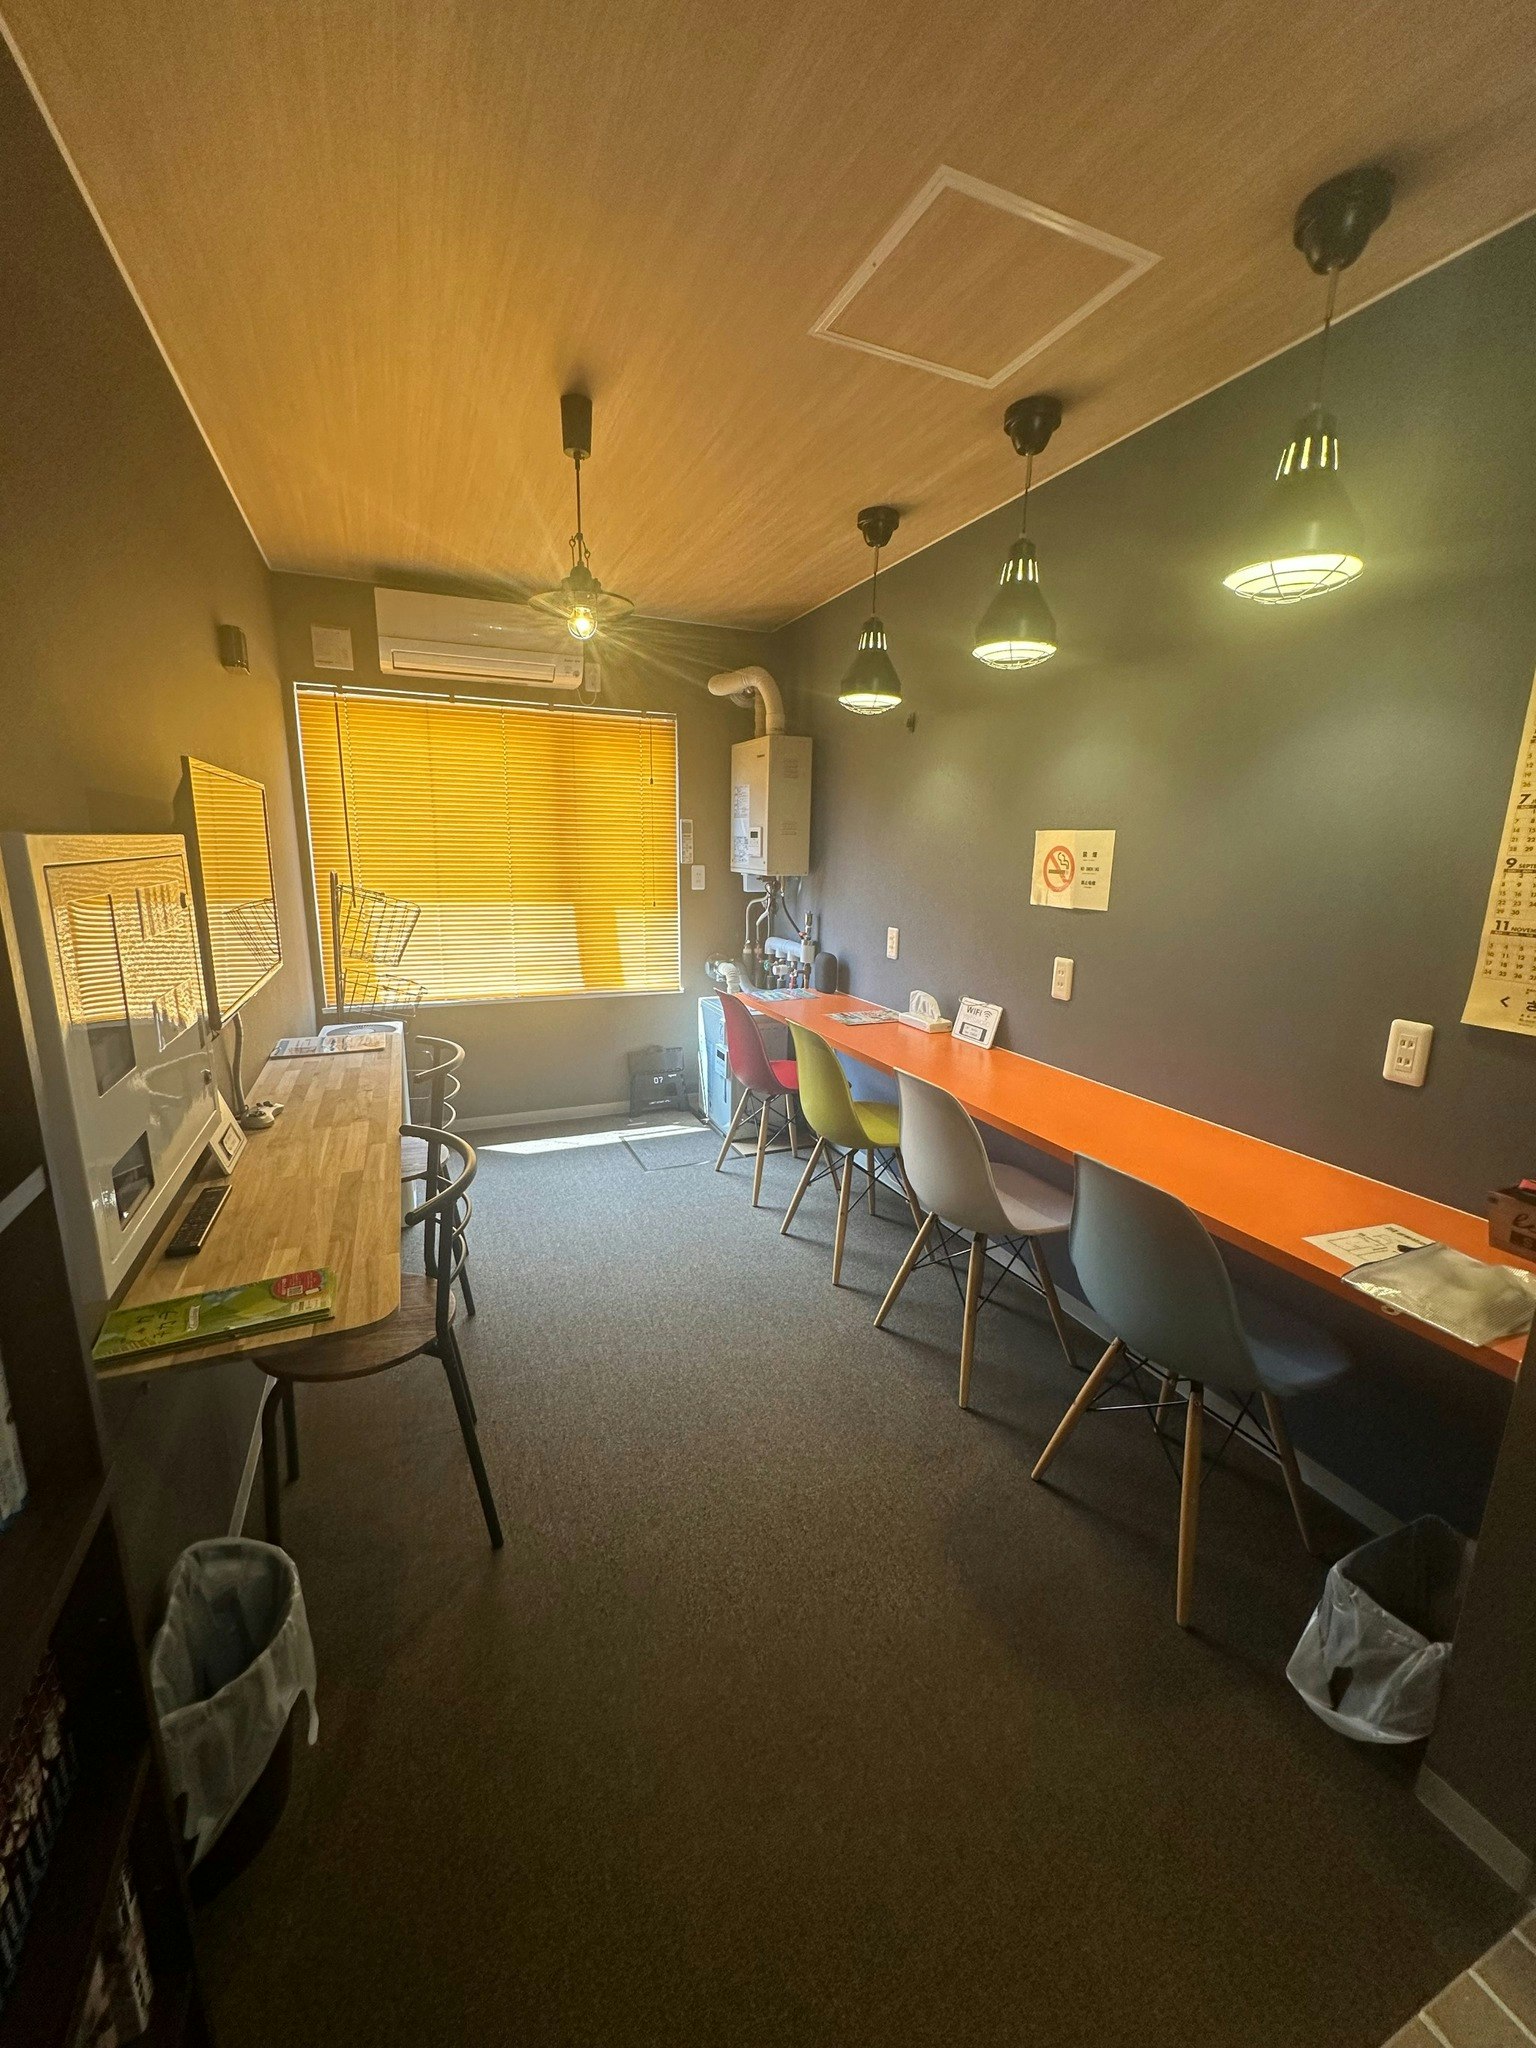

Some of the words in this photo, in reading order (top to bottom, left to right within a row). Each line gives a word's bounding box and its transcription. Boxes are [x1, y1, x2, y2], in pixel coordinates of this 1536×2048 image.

[1519, 793, 1532, 804] 7
[1506, 857, 1518, 869] 9
[1496, 920, 1510, 930] 11
